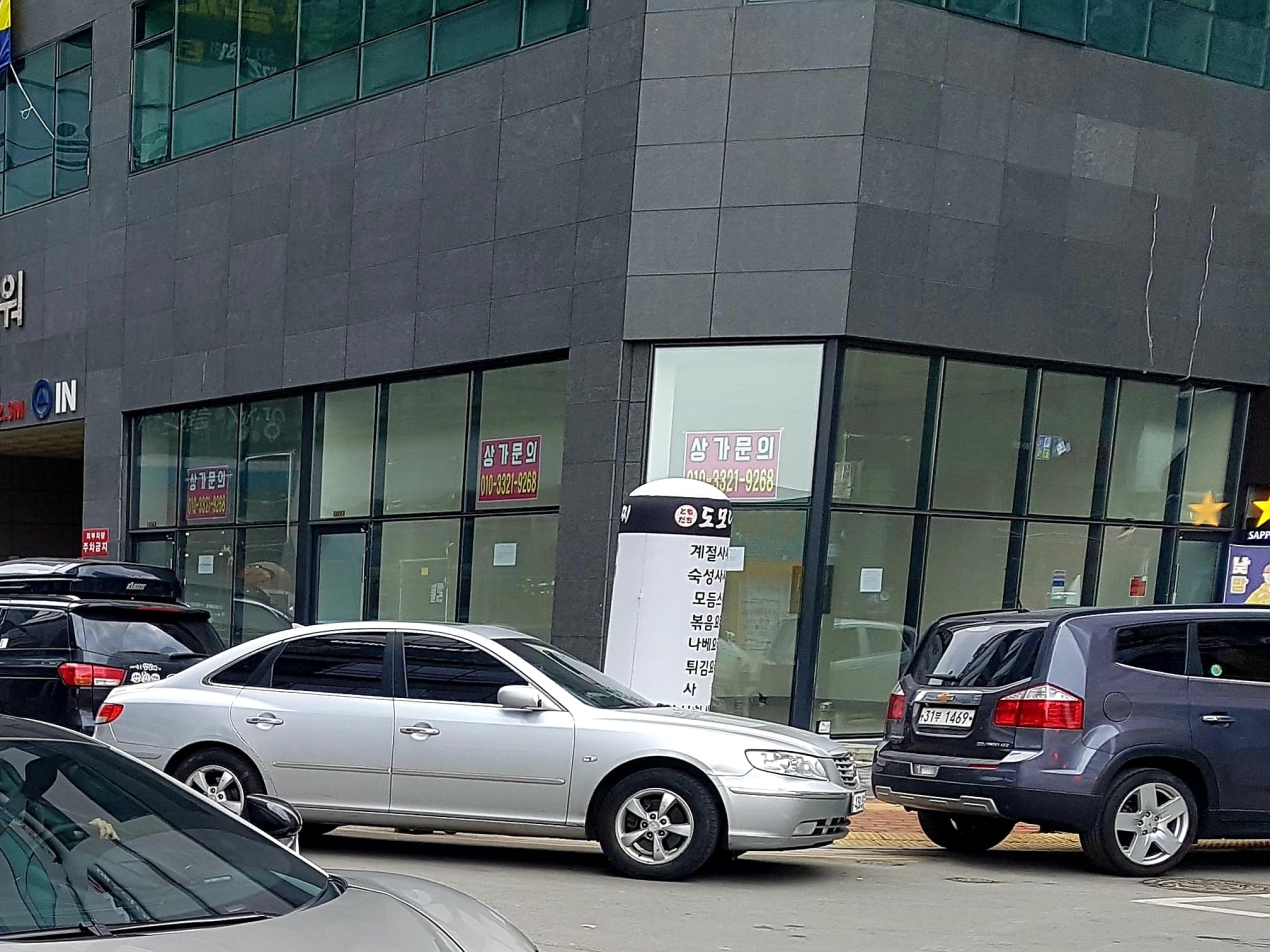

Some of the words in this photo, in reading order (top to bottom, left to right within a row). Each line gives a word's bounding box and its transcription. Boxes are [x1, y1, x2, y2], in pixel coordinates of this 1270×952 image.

[55, 379, 77, 414] IN
[483, 440, 538, 468] 상가문의
[690, 436, 775, 462] 상가문의
[189, 470, 227, 491] 상가문의
[480, 470, 537, 496] 010-3321-9268
[698, 506, 733, 529] 도모
[83, 542, 108, 553] 주차금지
[945, 711, 969, 724] 1469
